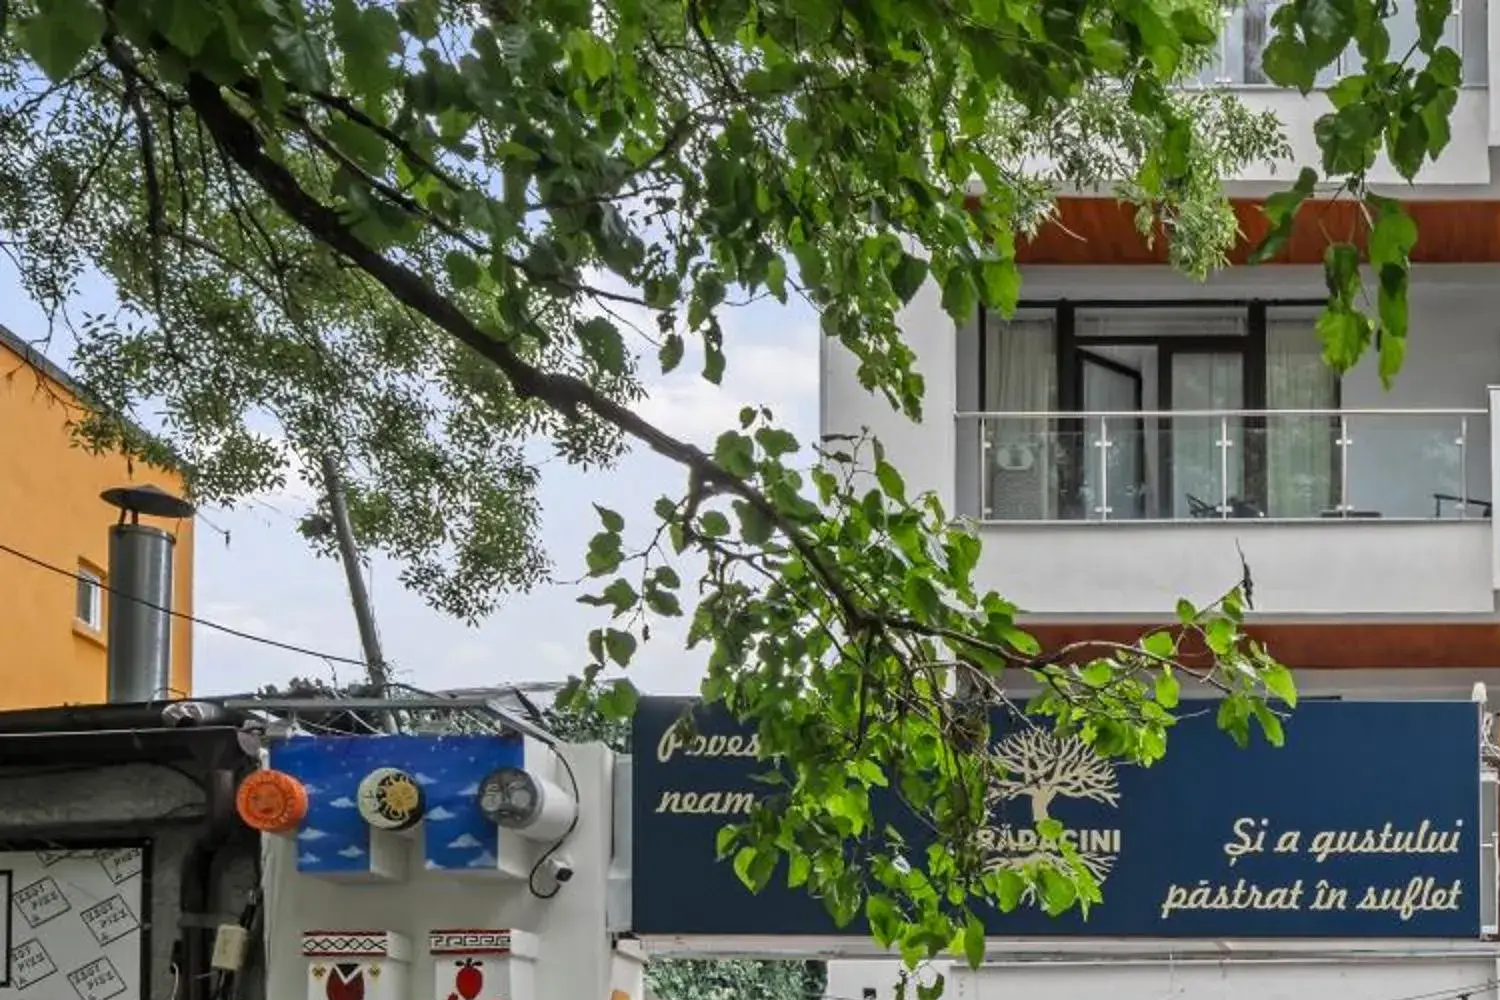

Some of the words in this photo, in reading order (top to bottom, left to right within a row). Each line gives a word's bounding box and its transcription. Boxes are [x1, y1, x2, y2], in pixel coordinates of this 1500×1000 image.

[657, 720, 763, 763] Poves
[655, 791, 762, 814] neam
[1273, 830, 1301, 853] a
[1307, 818, 1464, 864] gustului
[1161, 878, 1304, 919] păstrat
[1309, 879, 1347, 911] în
[1355, 876, 1463, 921] suflet
